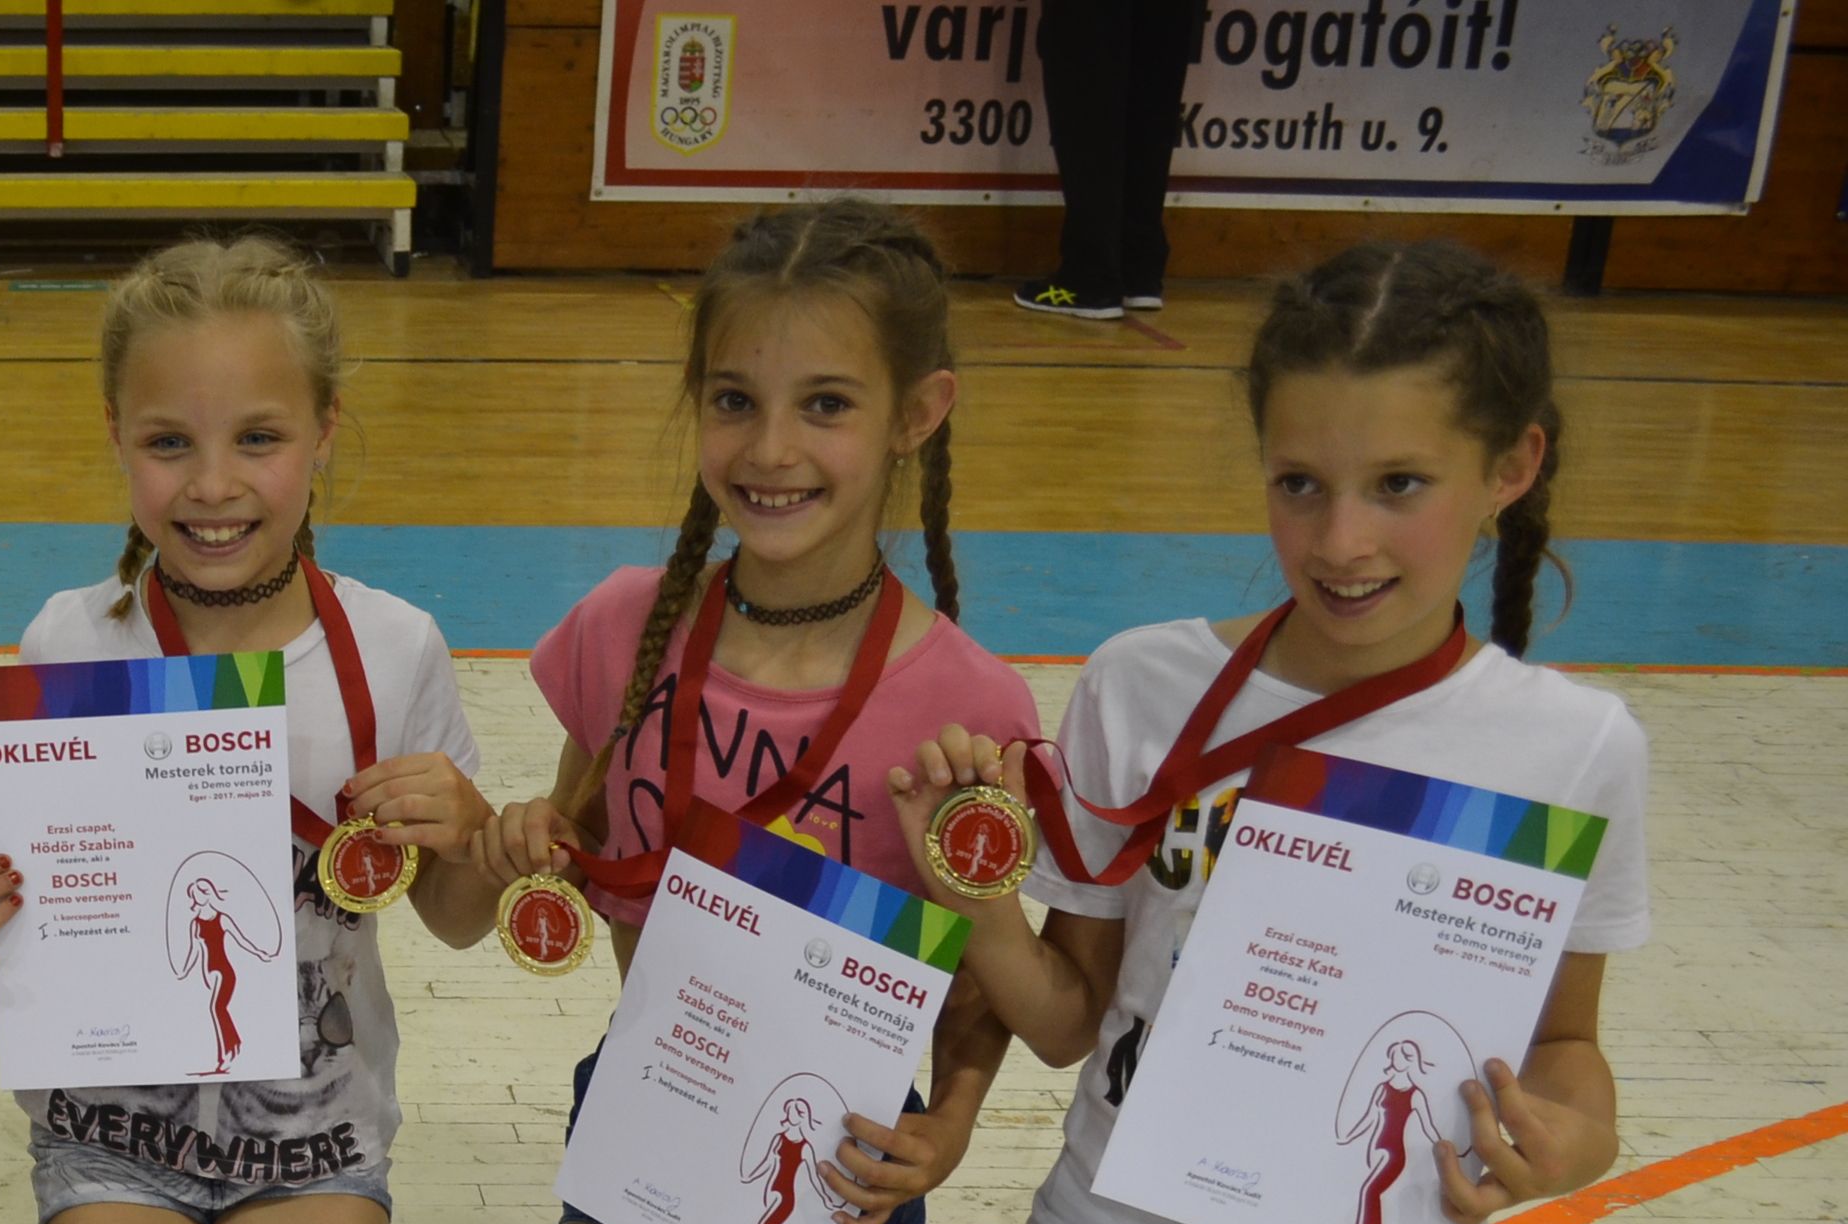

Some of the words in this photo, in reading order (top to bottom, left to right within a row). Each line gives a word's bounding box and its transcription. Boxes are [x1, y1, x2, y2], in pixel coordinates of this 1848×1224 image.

[665, 22, 715, 49] OLIMPIAI
[660, 50, 671, 98] MAGYAR
[660, 127, 714, 146] HUNGARY
[921, 99, 1032, 146] 3300
[1174, 102, 1343, 150] Kossuth
[1361, 120, 1397, 151] u.
[1418, 107, 1448, 153] 9.
[185, 730, 270, 753] BOSCH
[145, 763, 214, 779] Mesterek
[219, 760, 272, 775] tornája
[201, 781, 231, 789] Demo
[233, 779, 272, 787] verseny
[189, 794, 206, 802] Eger
[47, 824, 72, 834] Erzsi
[75, 823, 115, 834] csapat,
[79, 838, 134, 851] Szabina
[1235, 825, 1352, 871] OKLEVÉL
[52, 872, 116, 888] BOSCH
[39, 895, 72, 904] Demo
[75, 893, 132, 903] versenyen
[667, 874, 760, 936] OKLEVÉL
[1452, 878, 1556, 922] BOSCH
[59, 928, 101, 937] helyezést
[119, 925, 130, 933] el.
[60, 912, 119, 921] korcsoportban
[1395, 898, 1475, 931] Mesterek
[1480, 922, 1542, 949] tornája
[1264, 927, 1294, 942] Erzsi
[1295, 938, 1338, 957] csapat,
[1433, 944, 1453, 954] Eger
[1460, 951, 1486, 964] 2017.
[1488, 961, 1515, 972] május
[1437, 930, 1450, 940] és
[1453, 933, 1487, 950] Demo
[1490, 946, 1536, 966] verseny
[1246, 942, 1304, 967] Kertész
[1307, 959, 1342, 978] Kata
[688, 976, 712, 993] Erzsi
[712, 990, 746, 1013] csapat,
[841, 957, 927, 1008] BOSCH
[1297, 975, 1310, 983] aki
[677, 988, 713, 1015] Szabó
[716, 1009, 748, 1032] Gréti
[794, 968, 859, 1007] Mesterek
[863, 1001, 914, 1031] tornája
[1244, 982, 1317, 1015] BOSCH
[713, 1026, 724, 1034] aki
[824, 1015, 841, 1026] Eger
[845, 1024, 866, 1040] 2017.
[869, 1037, 890, 1049] május
[827, 1004, 837, 1013] és
[840, 1008, 868, 1026] Demo
[871, 1024, 908, 1046] verseny
[1222, 999, 1258, 1017] Demo
[1262, 1012, 1324, 1036] versenyen
[671, 1024, 729, 1063] BOSCH
[1237, 1026, 1301, 1051] korcsoportban
[654, 1036, 682, 1057] Demo
[685, 1054, 734, 1084] versenyen
[1228, 1042, 1275, 1063] helyezést
[1277, 1058, 1292, 1067] ért
[1293, 1063, 1306, 1072] el.
[658, 1076, 695, 1101] helyezést
[696, 1098, 707, 1108] ért
[708, 1105, 718, 1114] el.
[46, 1088, 366, 1183] EVERYWHERE
